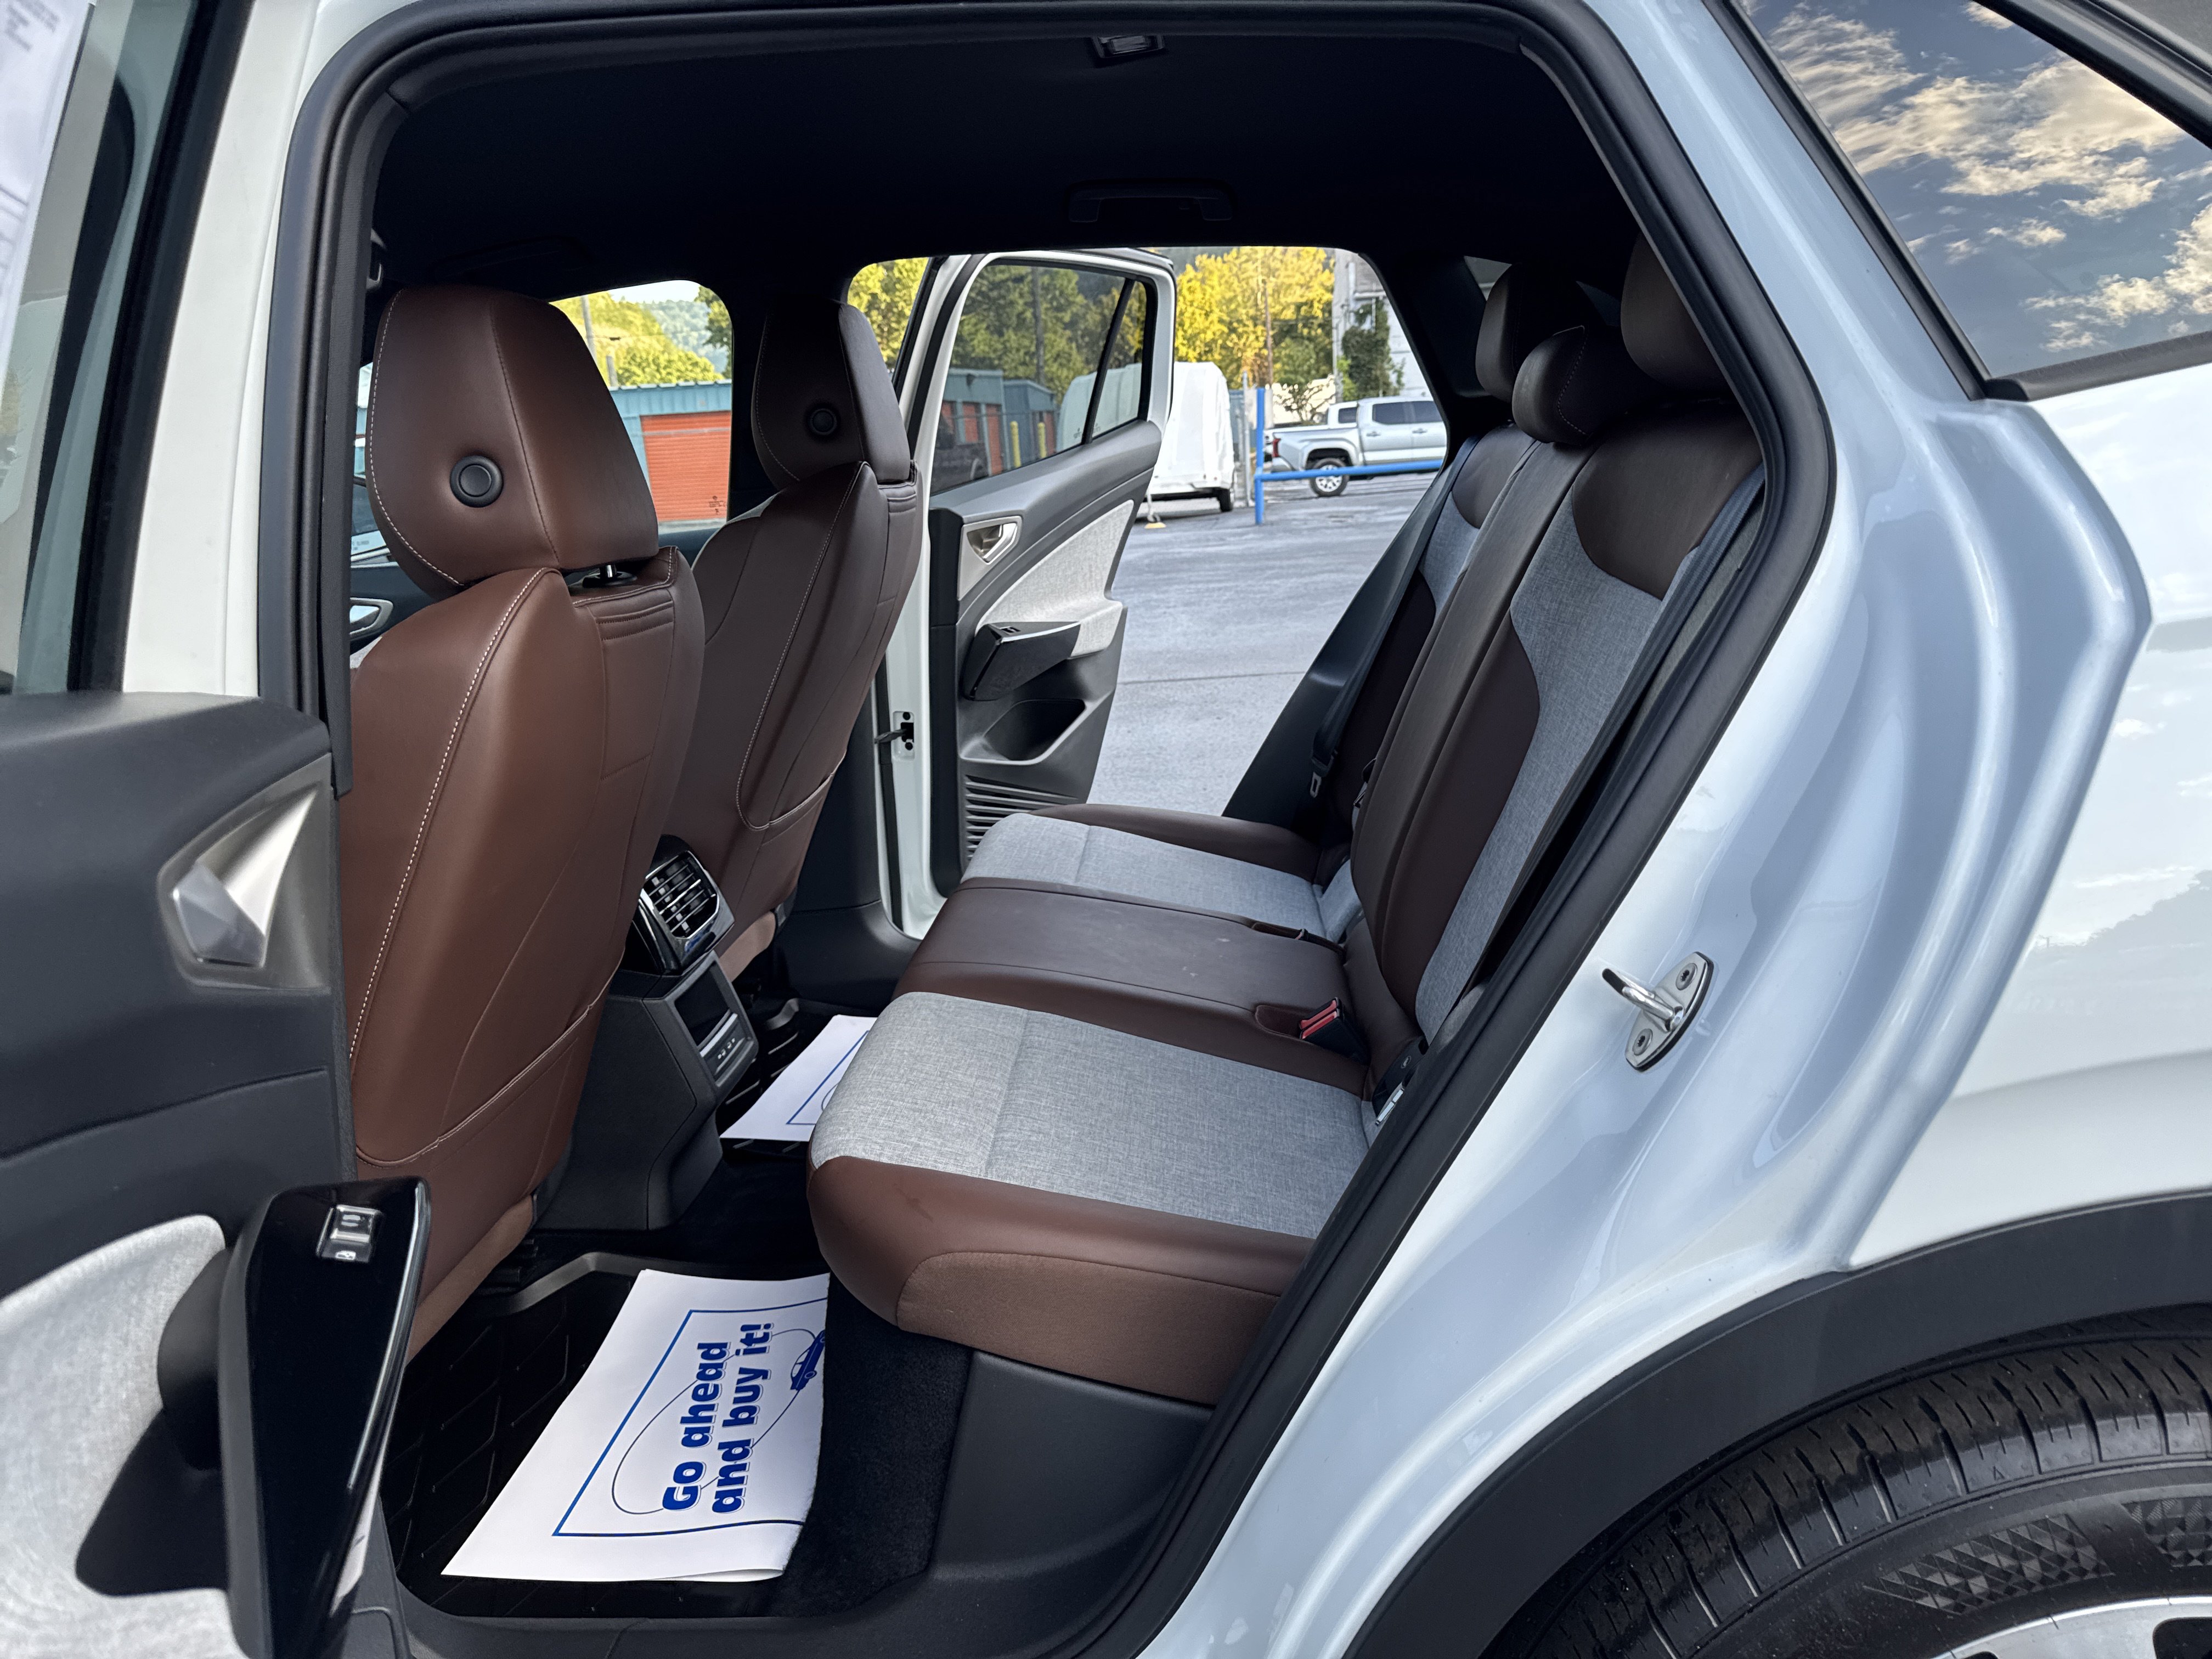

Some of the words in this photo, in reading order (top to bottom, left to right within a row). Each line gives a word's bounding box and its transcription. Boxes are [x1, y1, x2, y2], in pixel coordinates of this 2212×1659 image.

[735, 1323, 774, 1357] it!
[680, 1342, 731, 1448] ahead
[723, 1367, 772, 1427] buy
[662, 1461, 706, 1511] Go
[712, 1438, 754, 1514] and
